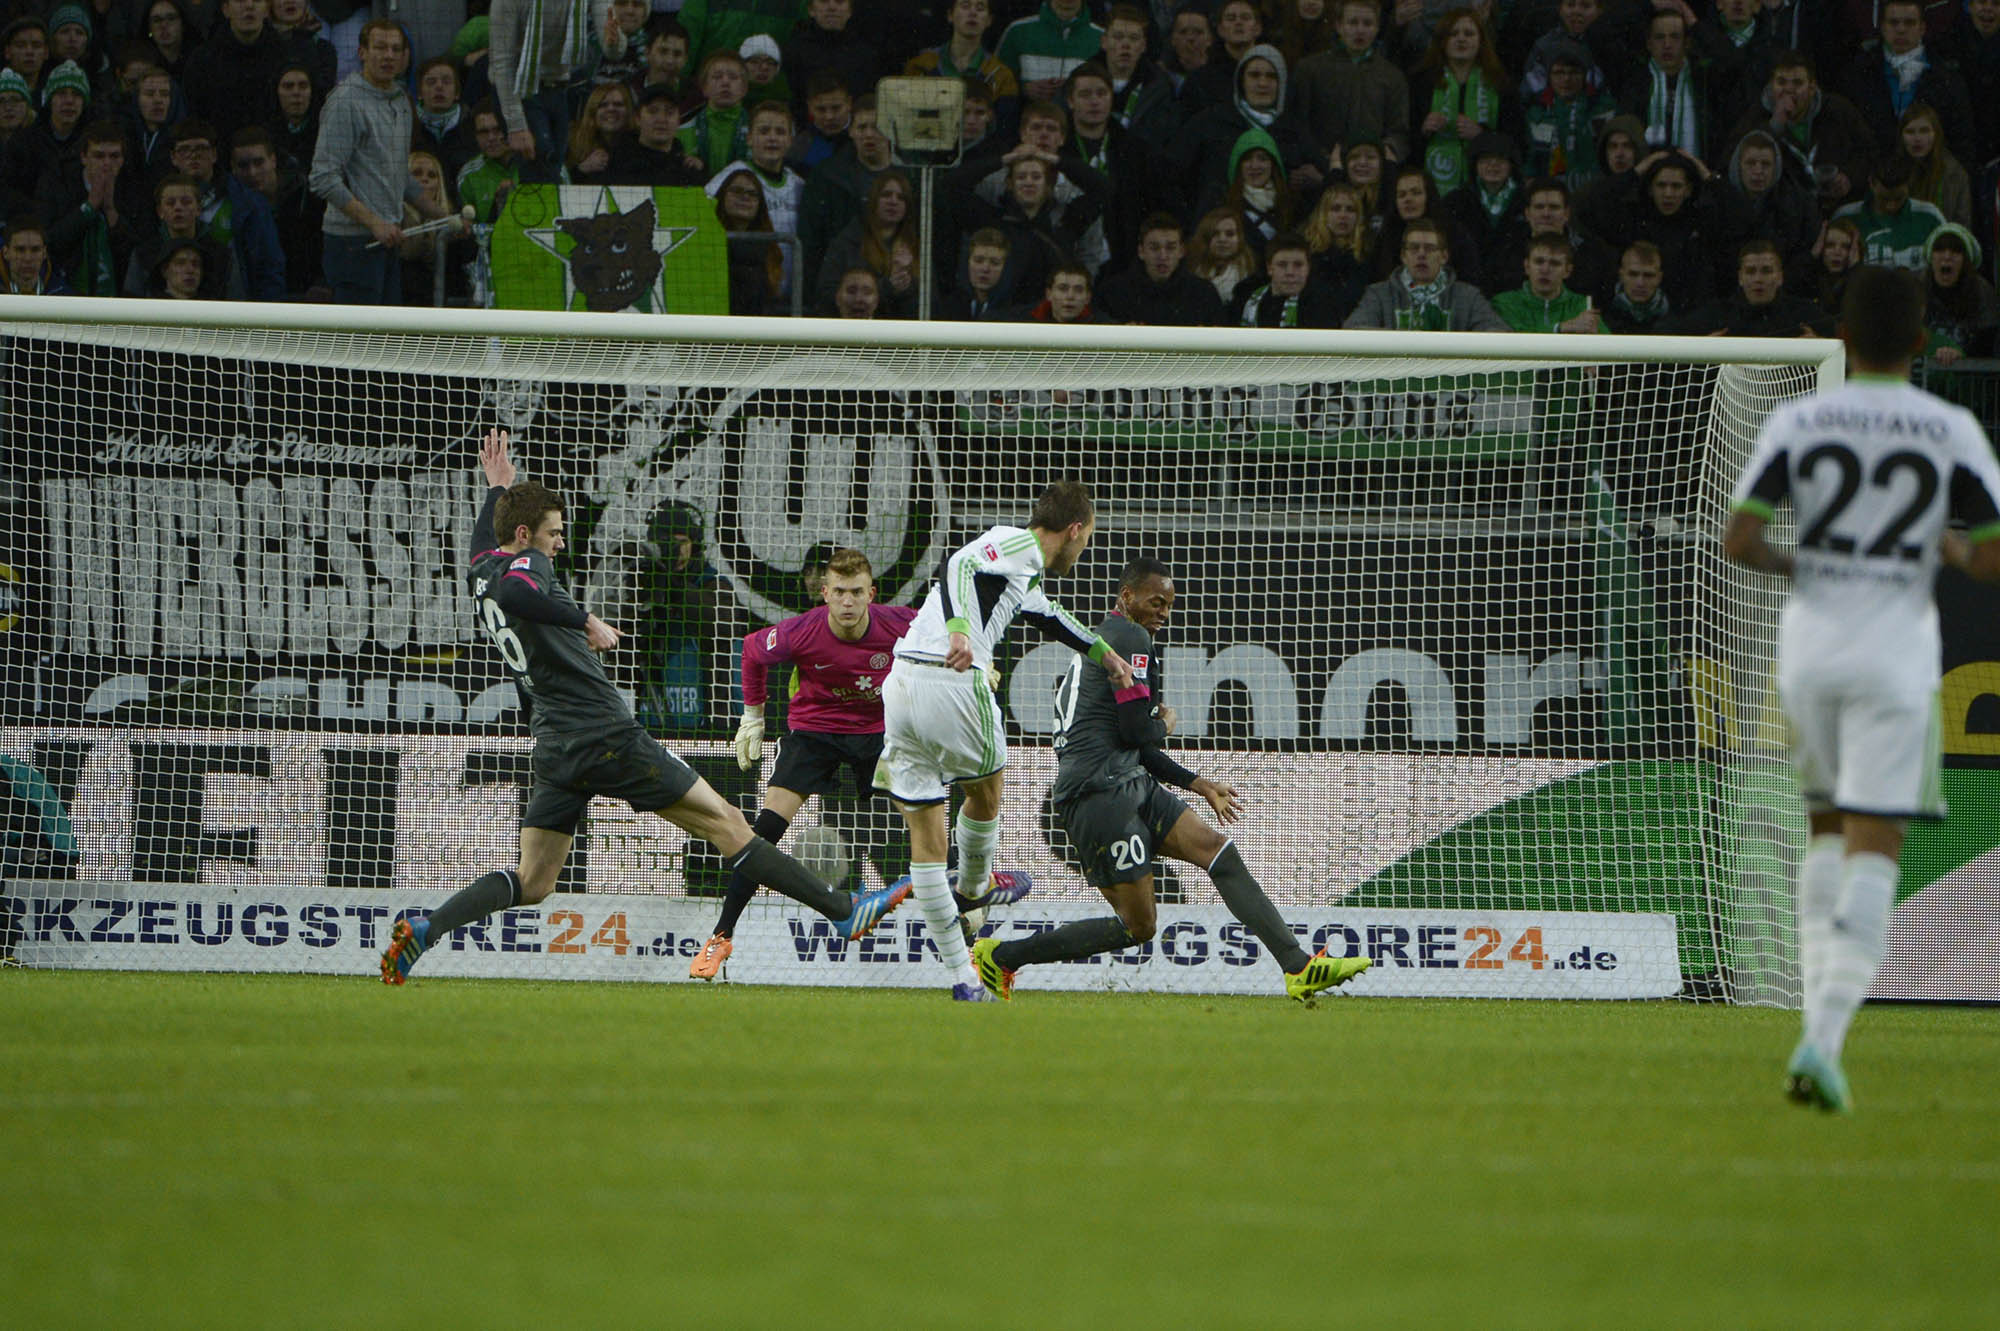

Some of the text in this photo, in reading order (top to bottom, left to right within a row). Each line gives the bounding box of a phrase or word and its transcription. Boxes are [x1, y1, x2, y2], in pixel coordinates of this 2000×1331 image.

[1796, 440, 1939, 562] 22
[476, 597, 528, 673] 6
[1053, 652, 1083, 734] 0
[1110, 834, 1146, 871] 20
